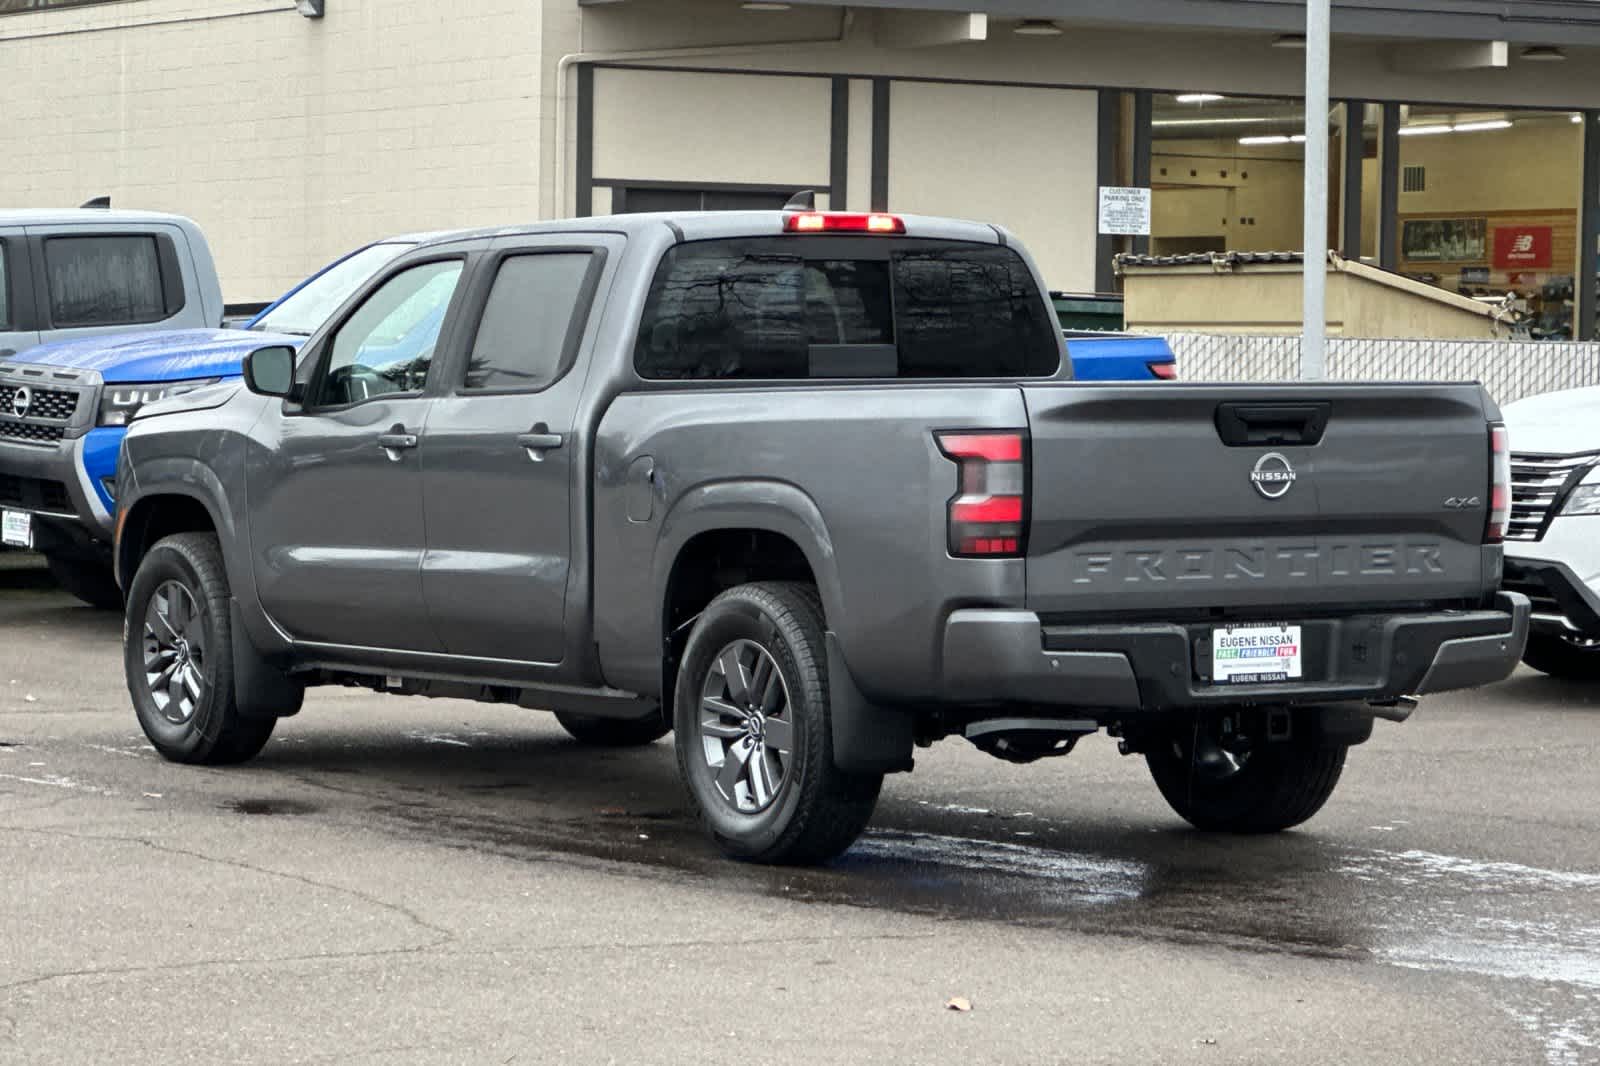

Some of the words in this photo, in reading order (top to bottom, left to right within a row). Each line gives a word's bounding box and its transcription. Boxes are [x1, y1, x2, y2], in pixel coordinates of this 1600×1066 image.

[1251, 472, 1296, 481] NISSAN
[1072, 544, 1443, 583] FRONTIER
[1220, 636, 1257, 647] EUGENE
[1260, 634, 1293, 645] NISSAN
[1232, 673, 1257, 682] EUGENE
[1261, 672, 1286, 680] NISSAN
